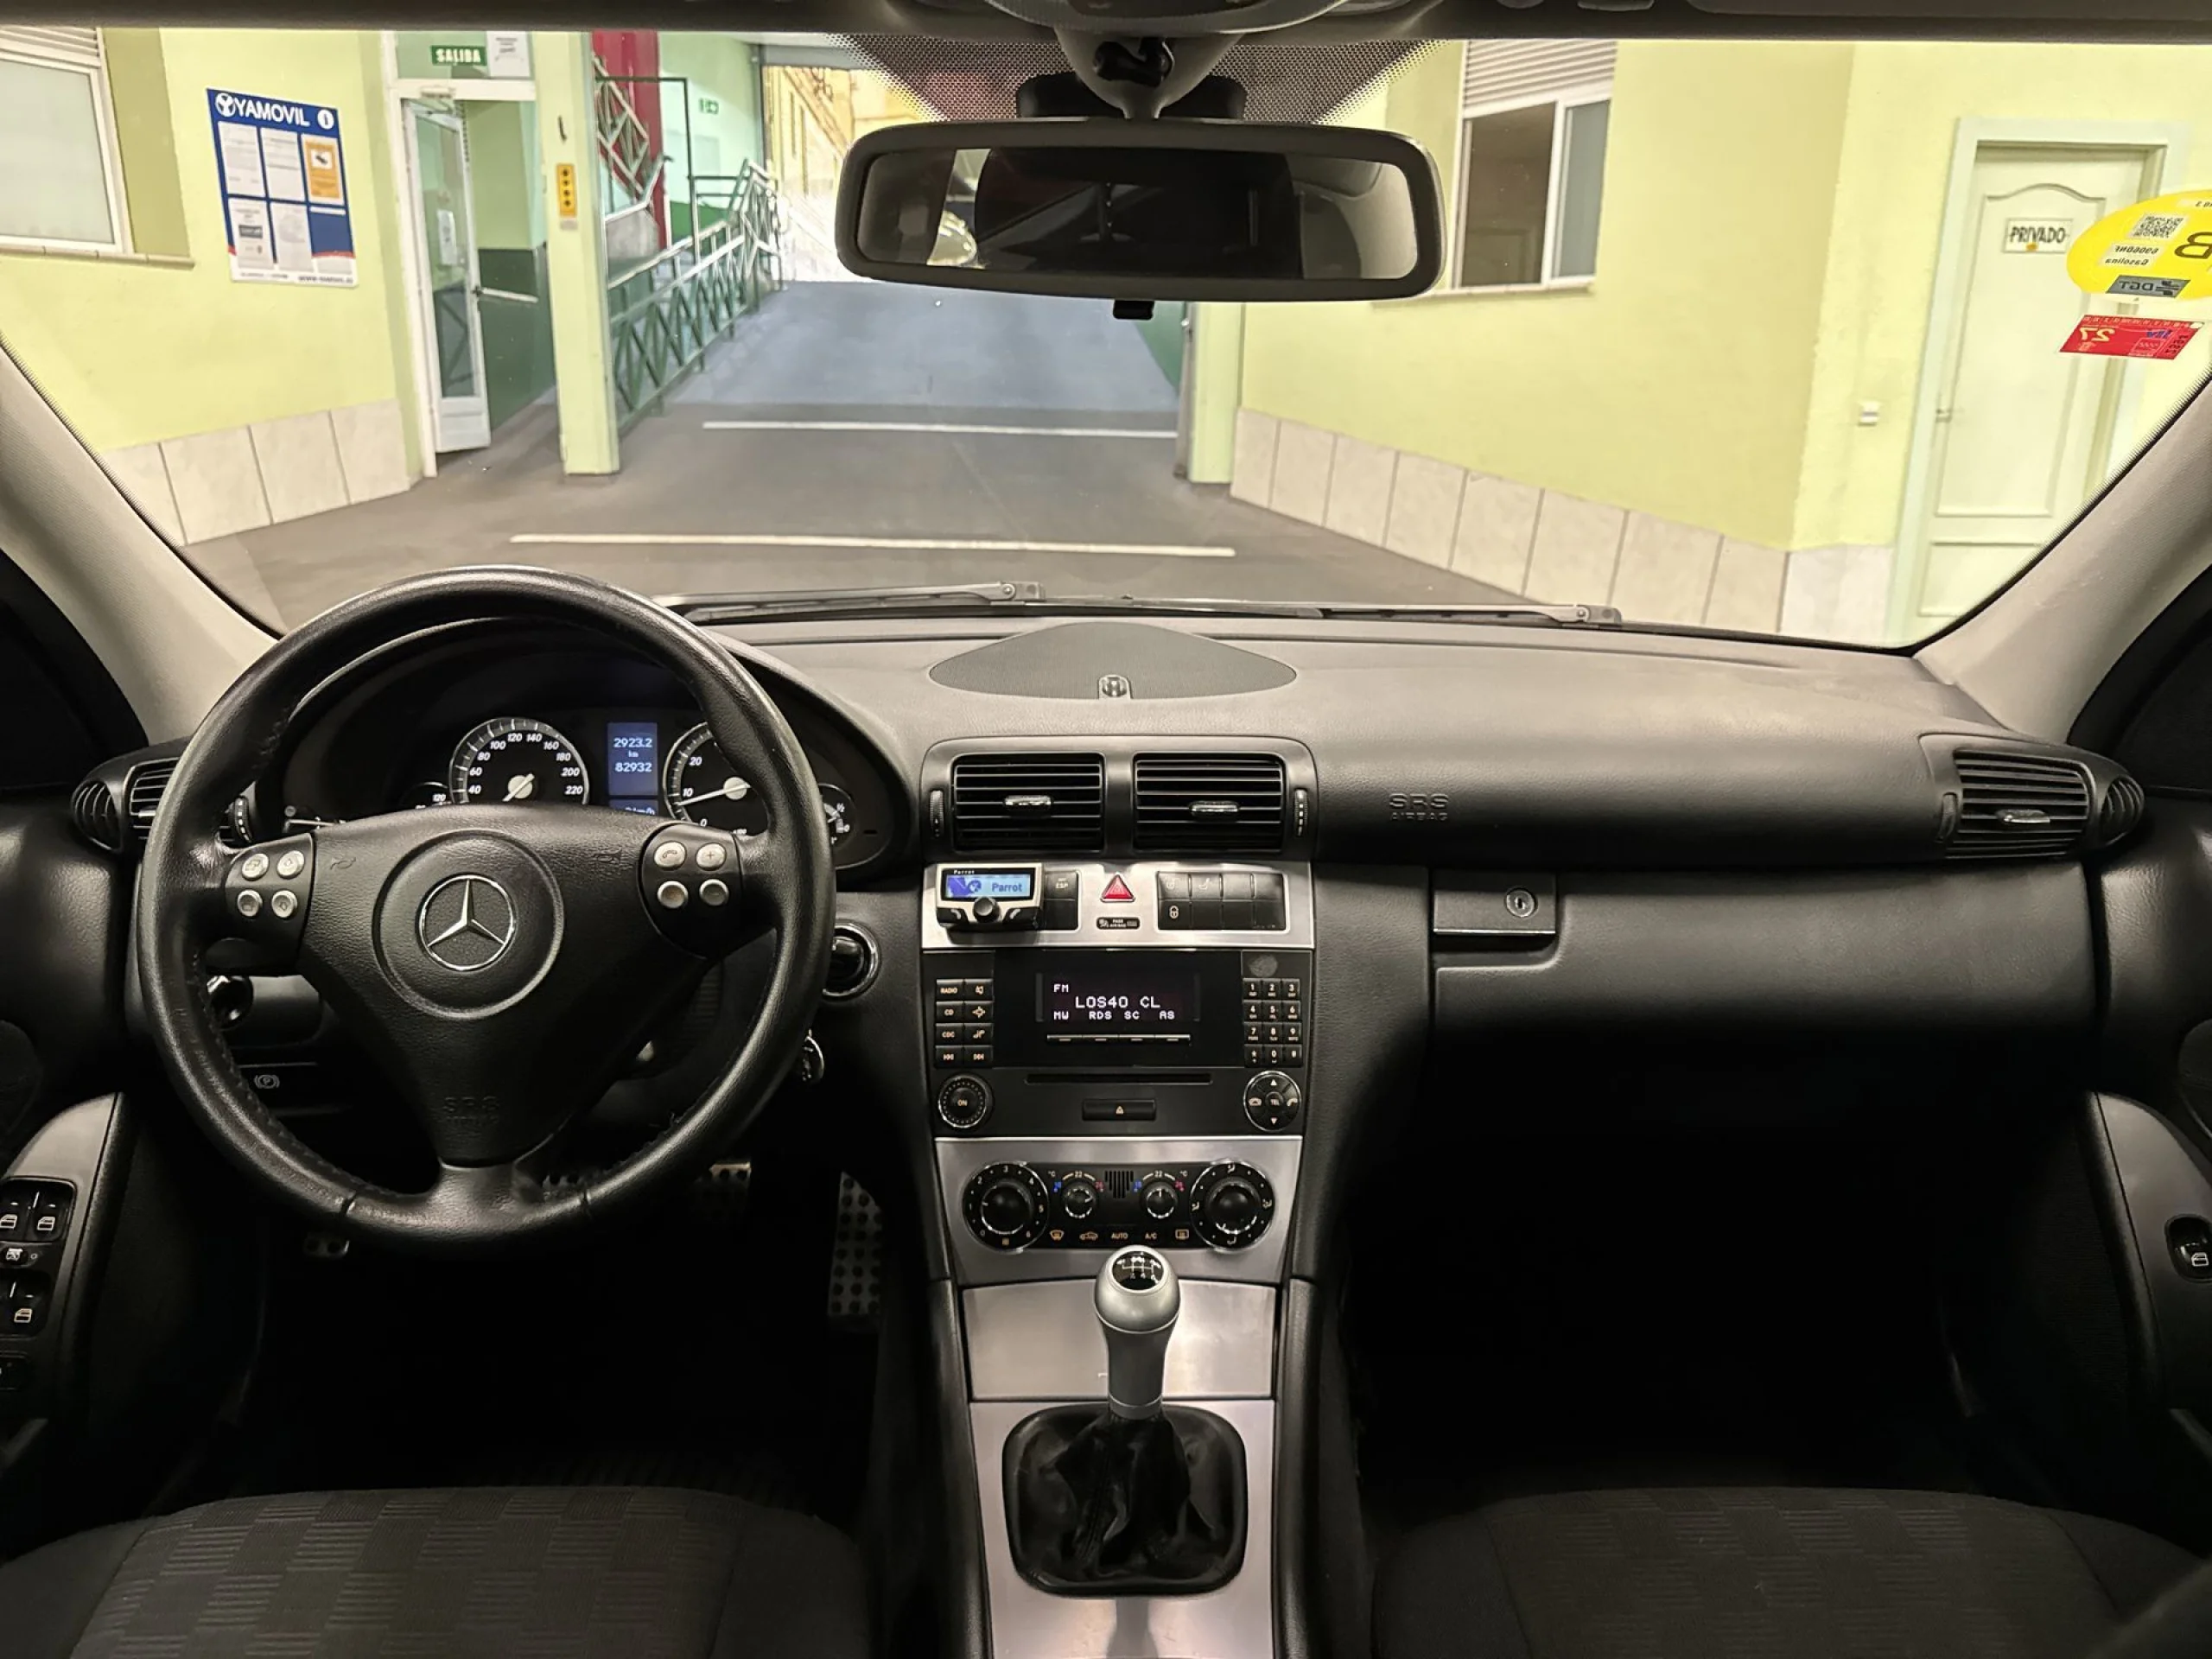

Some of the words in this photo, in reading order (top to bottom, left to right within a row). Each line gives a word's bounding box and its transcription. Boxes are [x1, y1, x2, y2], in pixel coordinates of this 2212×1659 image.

[435, 48, 481, 63] SALIDA
[234, 97, 310, 127] YAMOVIL
[2010, 226, 2066, 244] PRIVADO
[507, 733, 523, 742] 120
[526, 733, 543, 742] 140
[613, 737, 653, 748] 2923.2
[490, 741, 505, 750] 100
[543, 741, 559, 750] 160
[477, 752, 491, 761] 80
[556, 753, 571, 761] 180
[689, 757, 702, 766] 20
[469, 766, 483, 777] 60
[561, 767, 581, 777] 200
[614, 762, 652, 772] 82932
[468, 785, 481, 794] 40
[564, 785, 583, 795] 220
[683, 788, 694, 798] 10
[1389, 793, 1448, 808] SRS
[991, 882, 1023, 893] Parrot
[1053, 983, 1069, 993] FM
[1288, 983, 1294, 992] 3
[1075, 995, 1128, 1009] LOS40
[1140, 995, 1160, 1009] CL
[1053, 1011, 1069, 1020] MW
[1089, 1010, 1112, 1020] RDS
[1124, 1010, 1141, 1020] SC
[1159, 1011, 1175, 1020] AS
